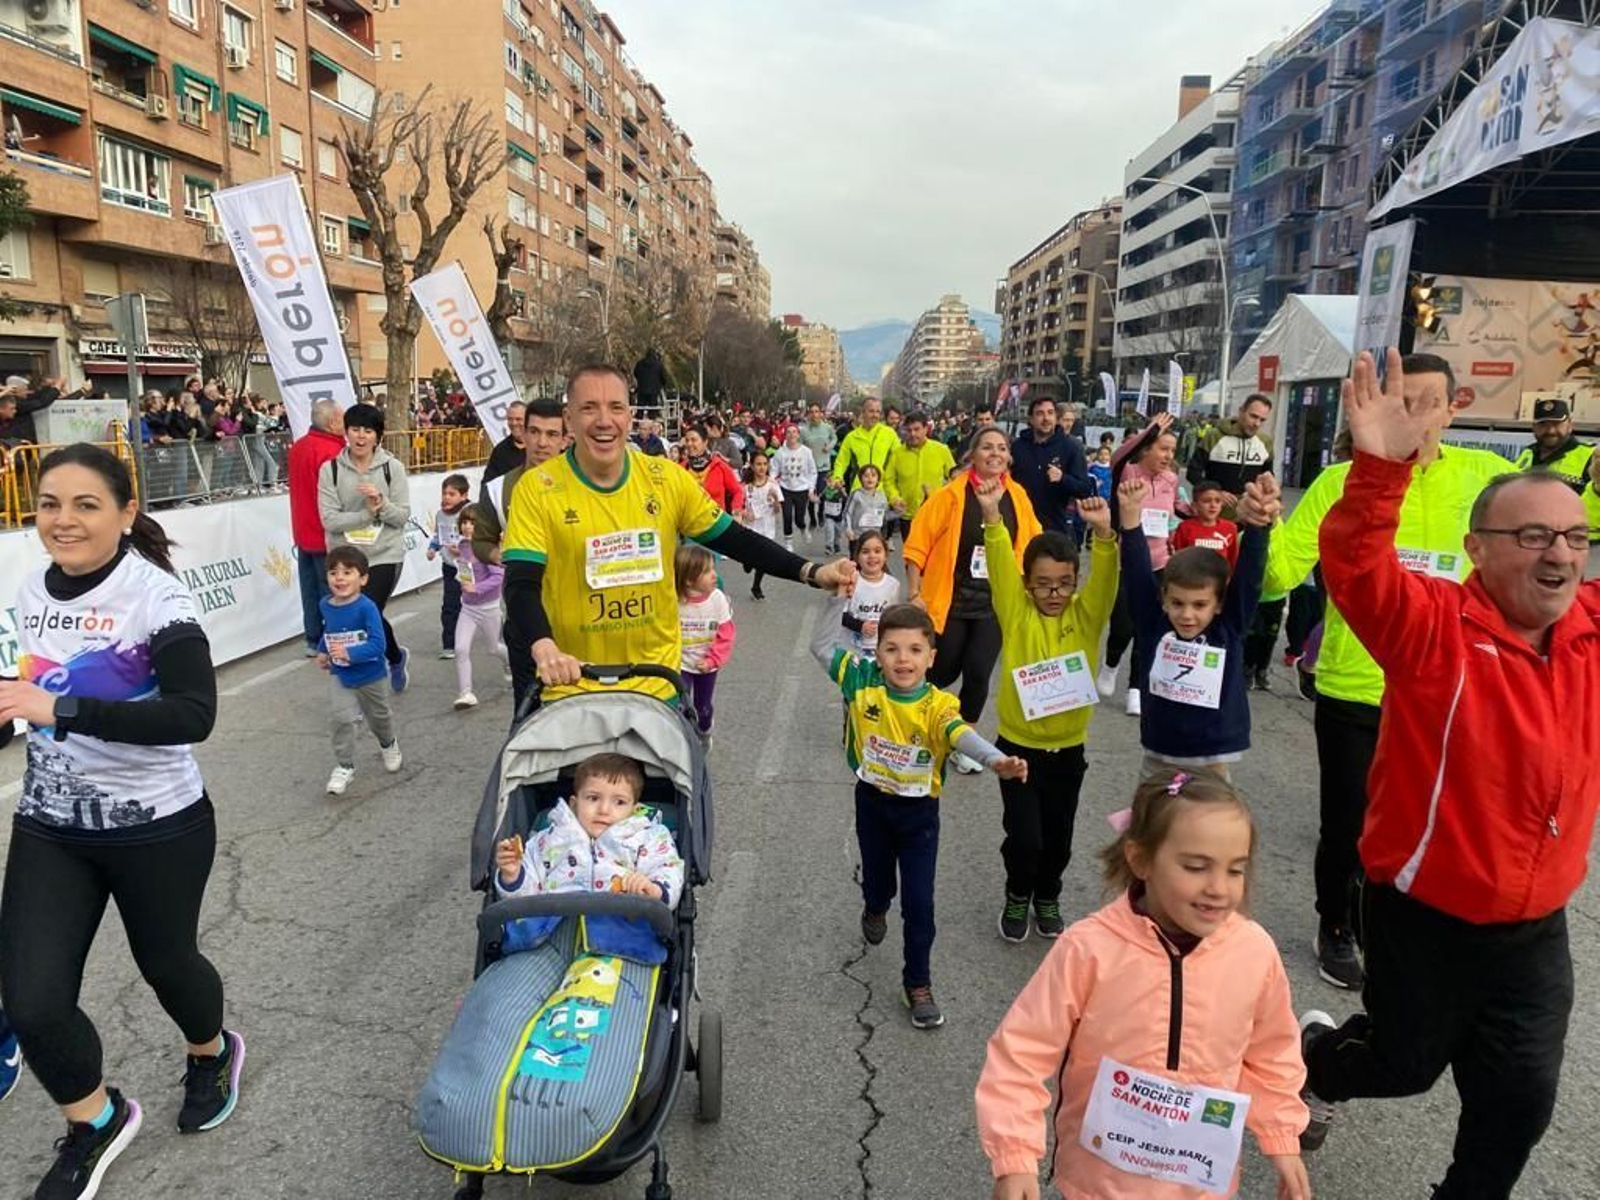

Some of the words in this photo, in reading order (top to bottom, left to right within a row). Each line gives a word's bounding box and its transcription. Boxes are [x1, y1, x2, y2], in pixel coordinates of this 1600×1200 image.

[1501, 64, 1530, 105] SAN
[1472, 296, 1516, 309] calde
[89, 341, 149, 354] CAFEIA
[1227, 450, 1261, 461] FILA
[1398, 552, 1418, 560] OCHE
[201, 557, 252, 585] RURAL
[198, 584, 237, 614] JAÉN
[589, 590, 653, 622] Jaén
[1174, 663, 1194, 681] 7
[1111, 1087, 1141, 1107] SAN
[1130, 1083, 1173, 1105] NOCHE
[1174, 1096, 1193, 1108] DE
[1107, 1131, 1135, 1146] CEIP
